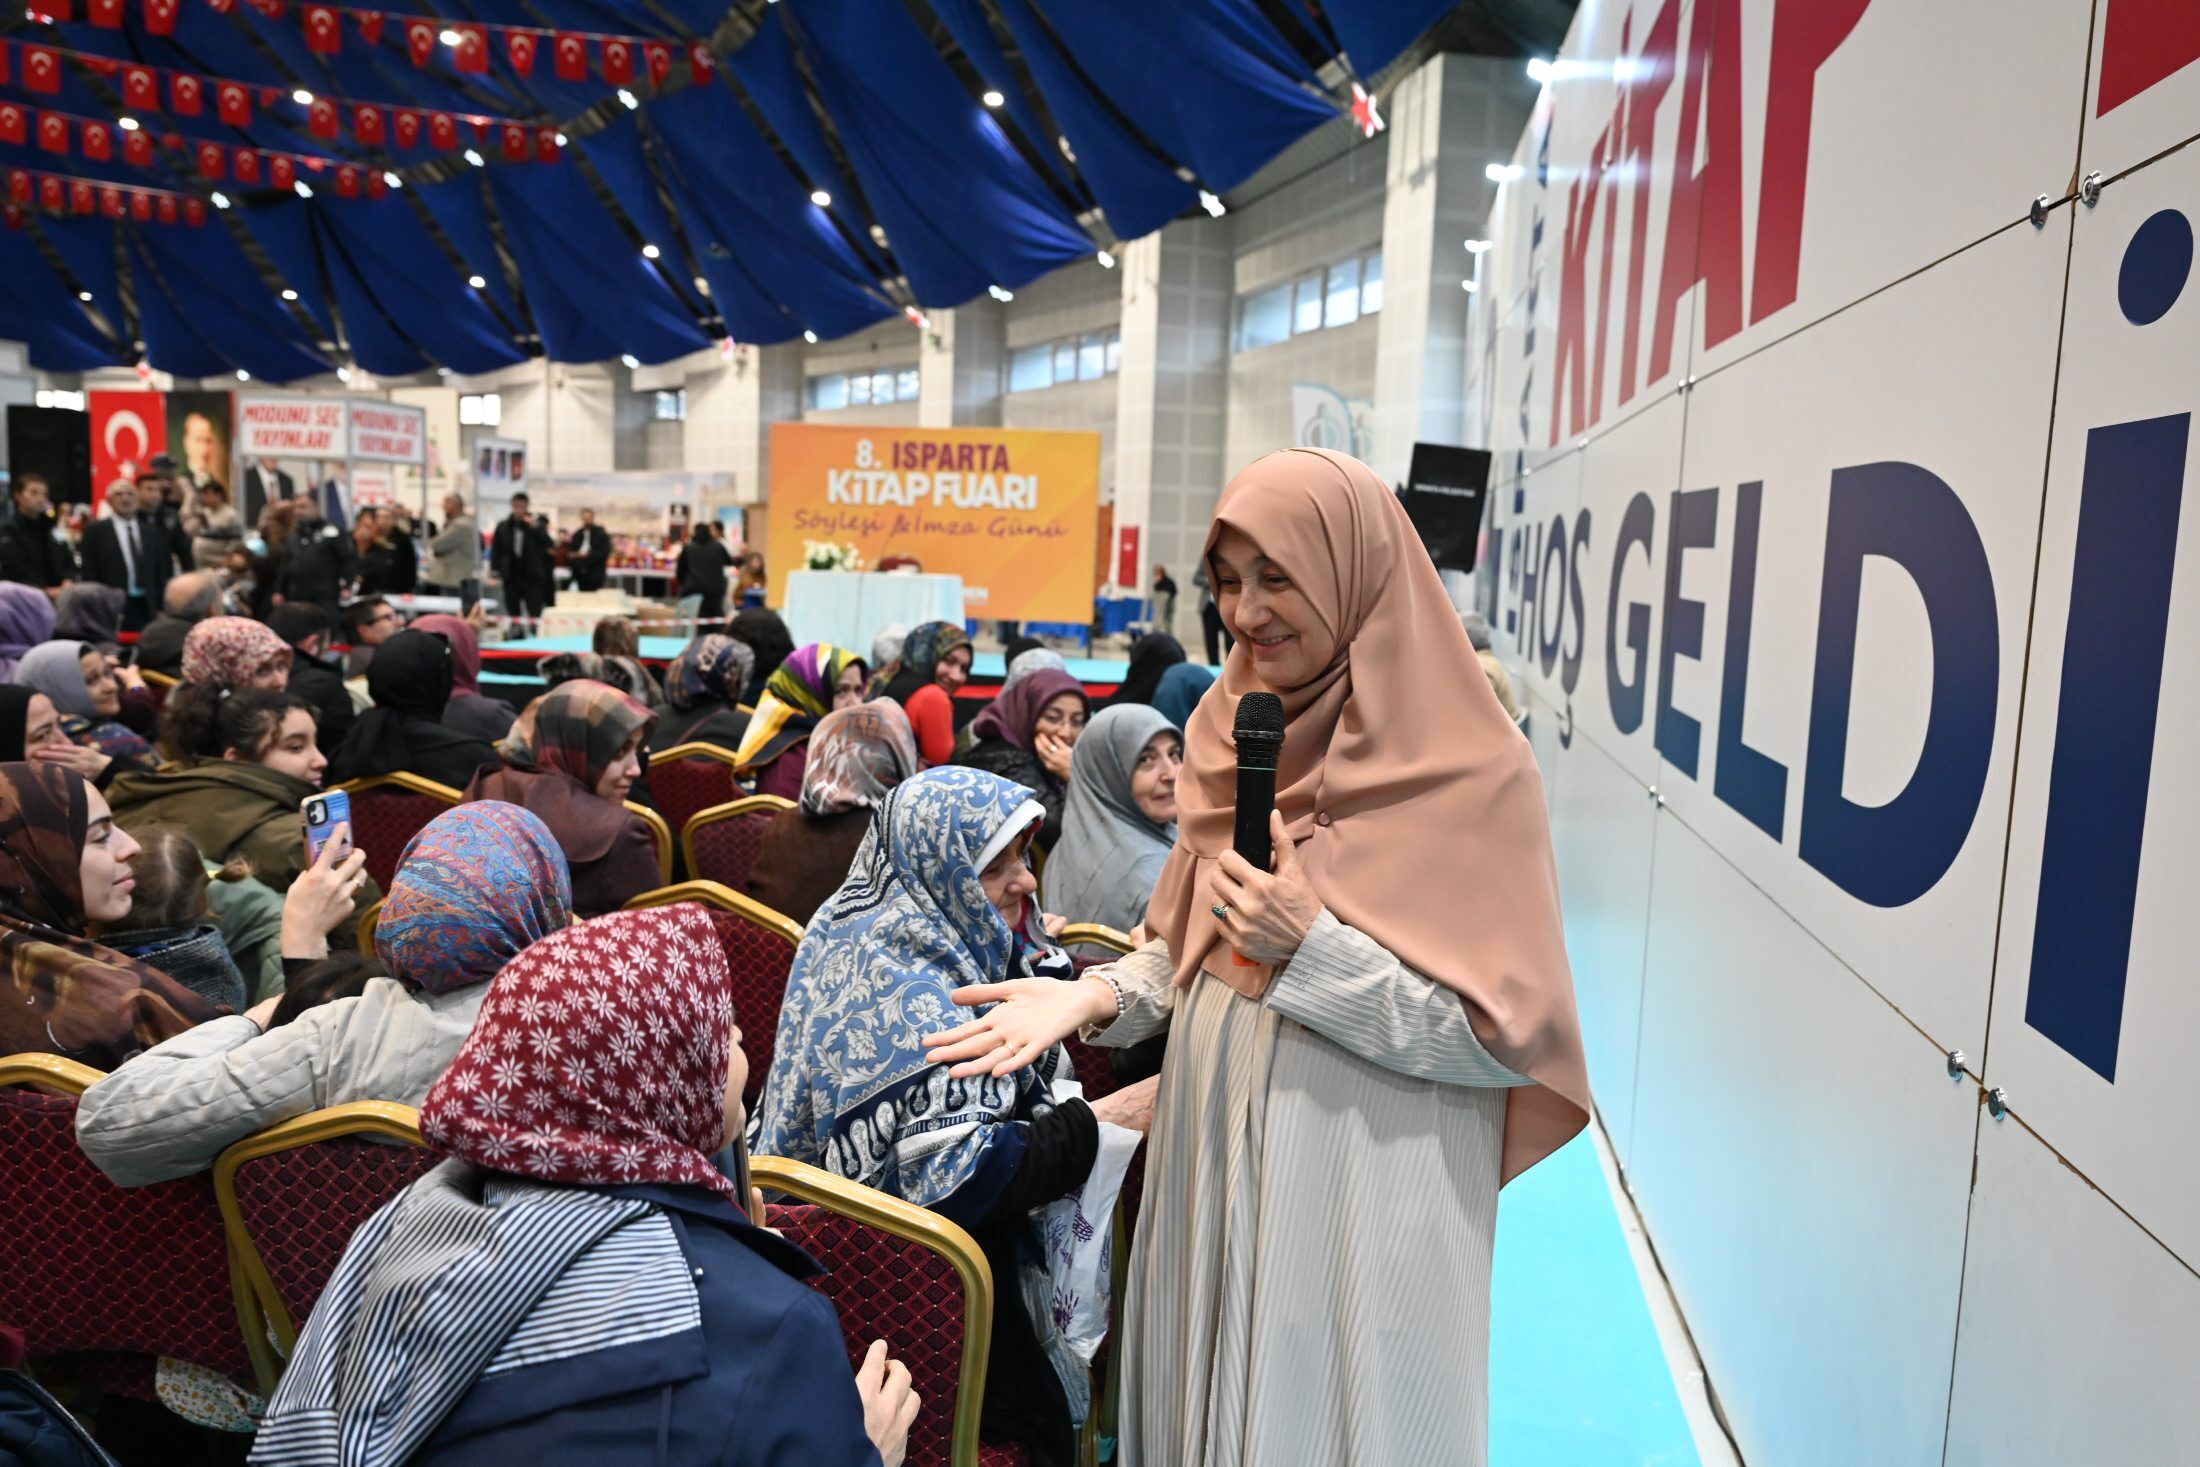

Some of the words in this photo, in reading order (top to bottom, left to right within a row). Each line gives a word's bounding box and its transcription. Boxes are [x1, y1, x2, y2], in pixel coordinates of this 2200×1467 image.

[855, 439, 882, 469] 8.
[893, 441, 1009, 472] ISPARTA
[933, 471, 1038, 511] FUARI
[1517, 507, 1592, 751] HOŞ
